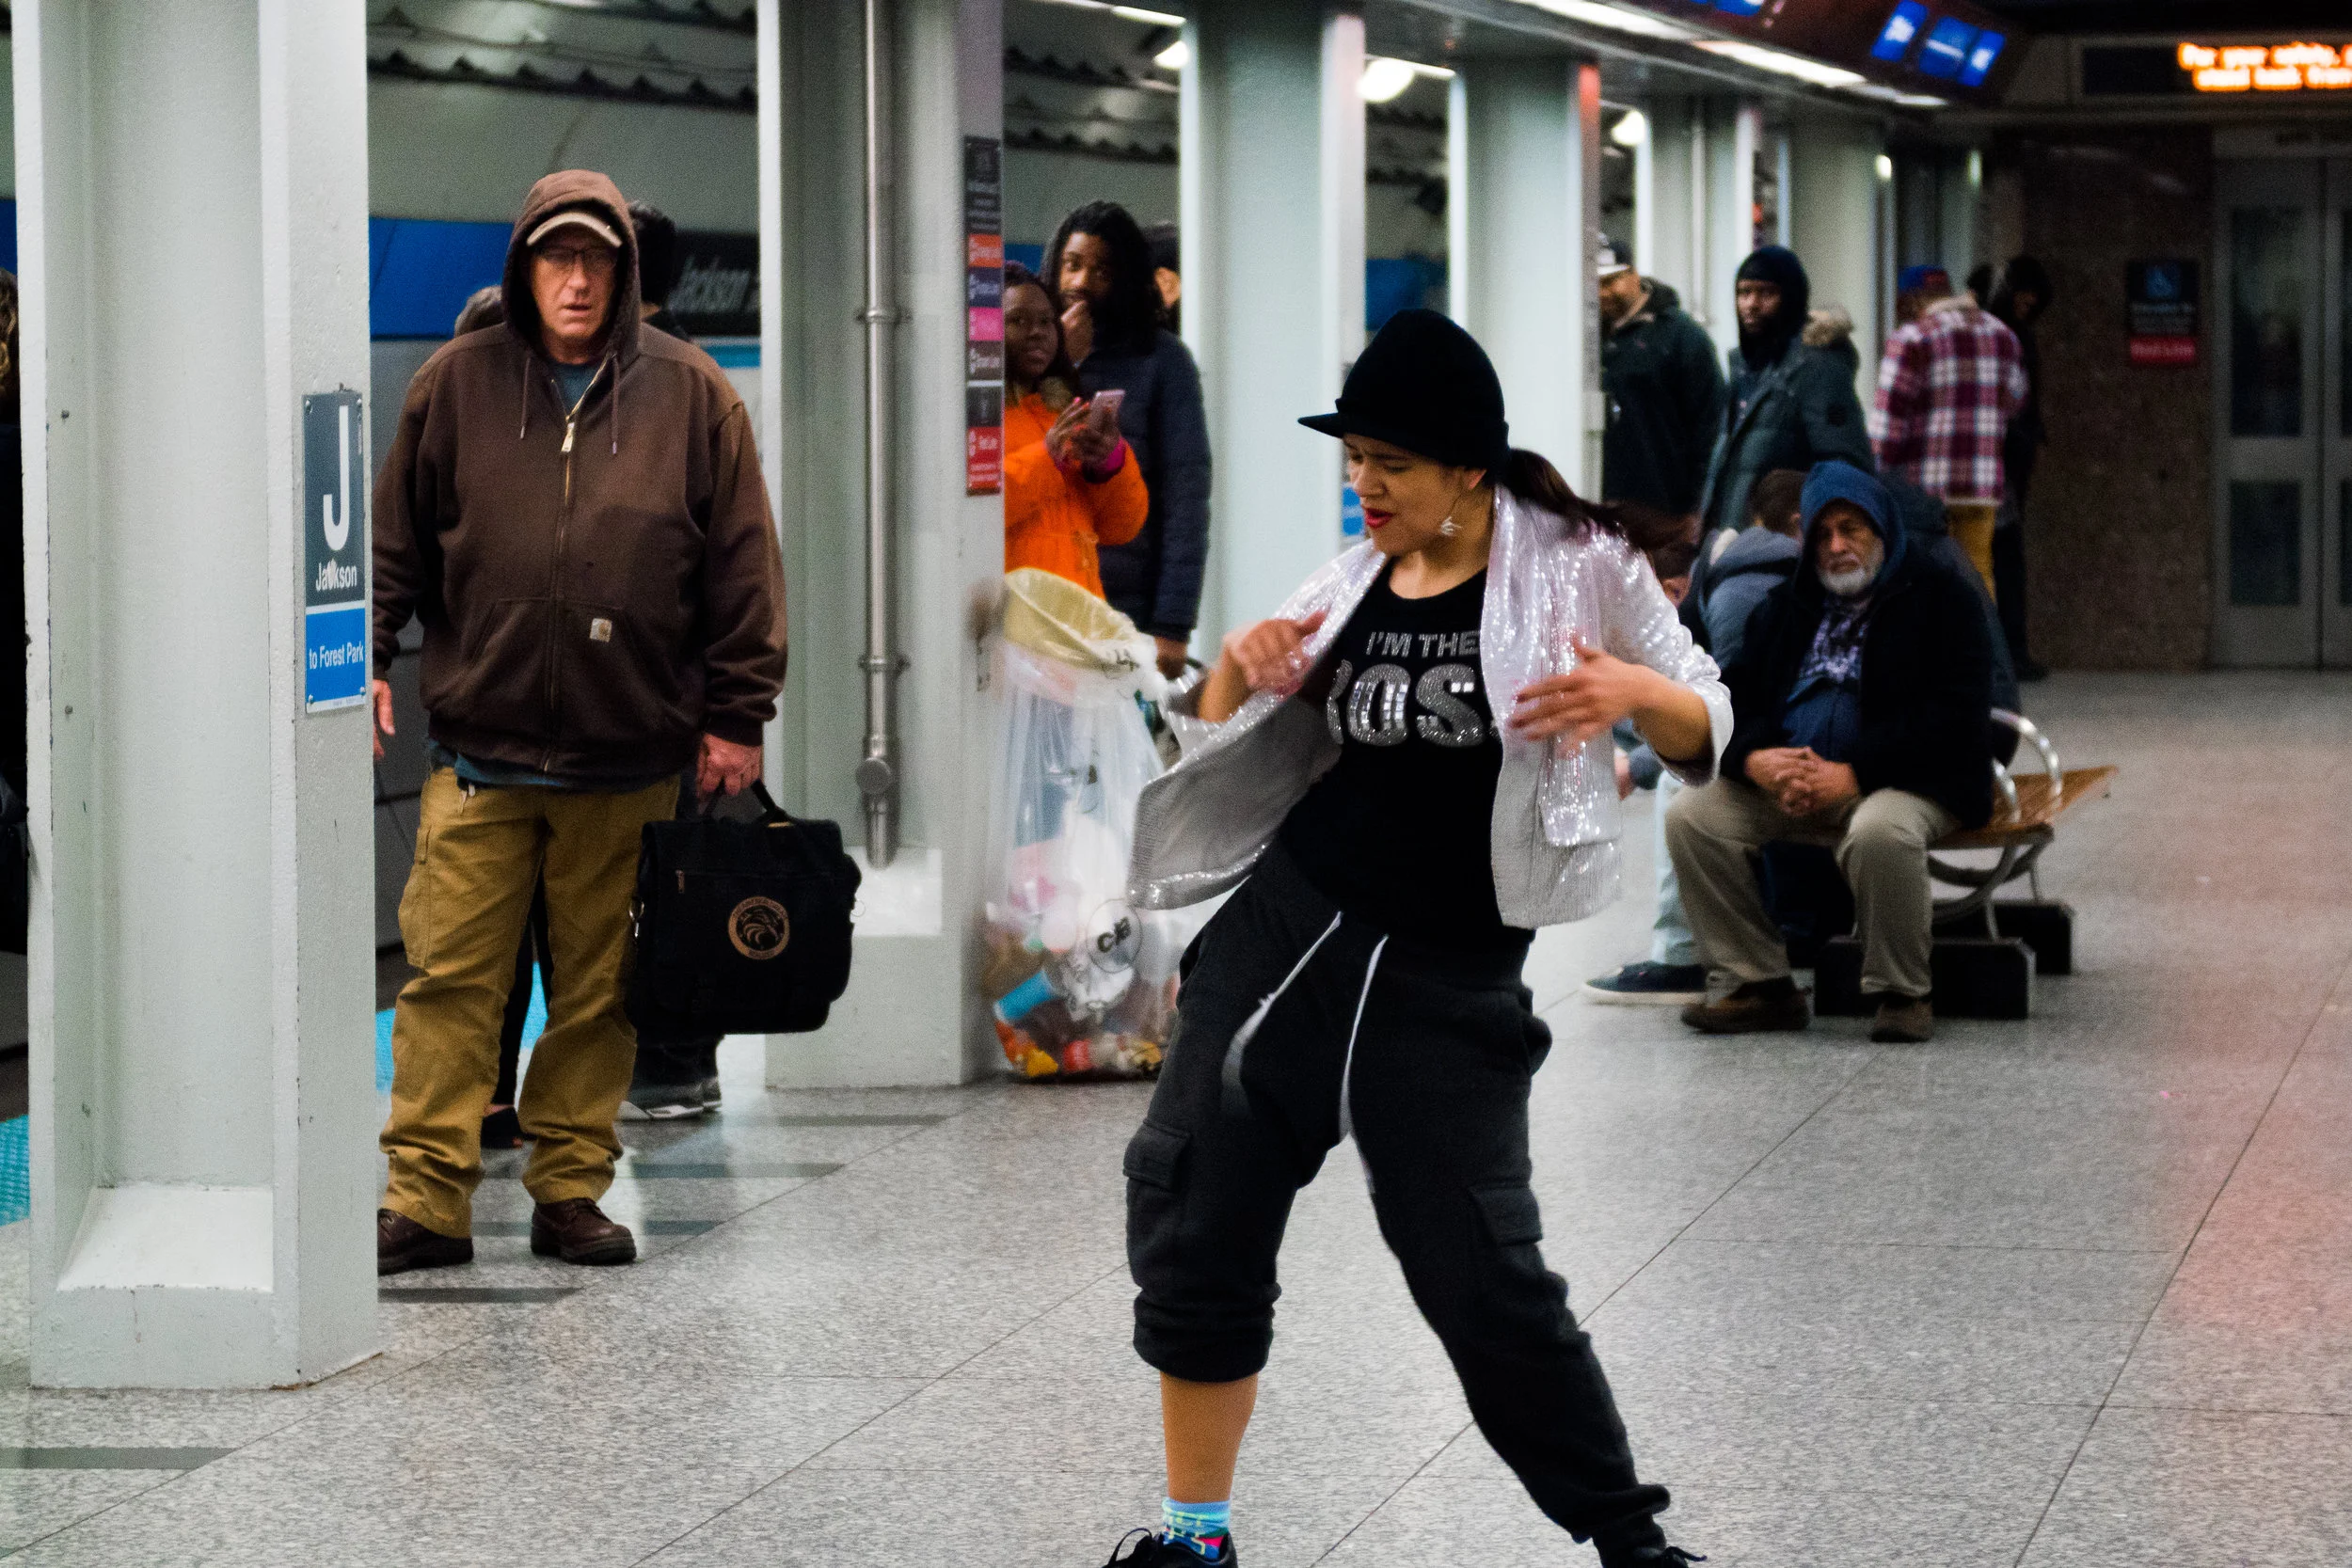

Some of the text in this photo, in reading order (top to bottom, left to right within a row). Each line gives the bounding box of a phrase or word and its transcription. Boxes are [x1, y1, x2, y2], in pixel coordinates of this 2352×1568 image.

[324, 405, 350, 551] J
[309, 641, 364, 670] to Forest Park
[1419, 630, 1480, 657] THE
